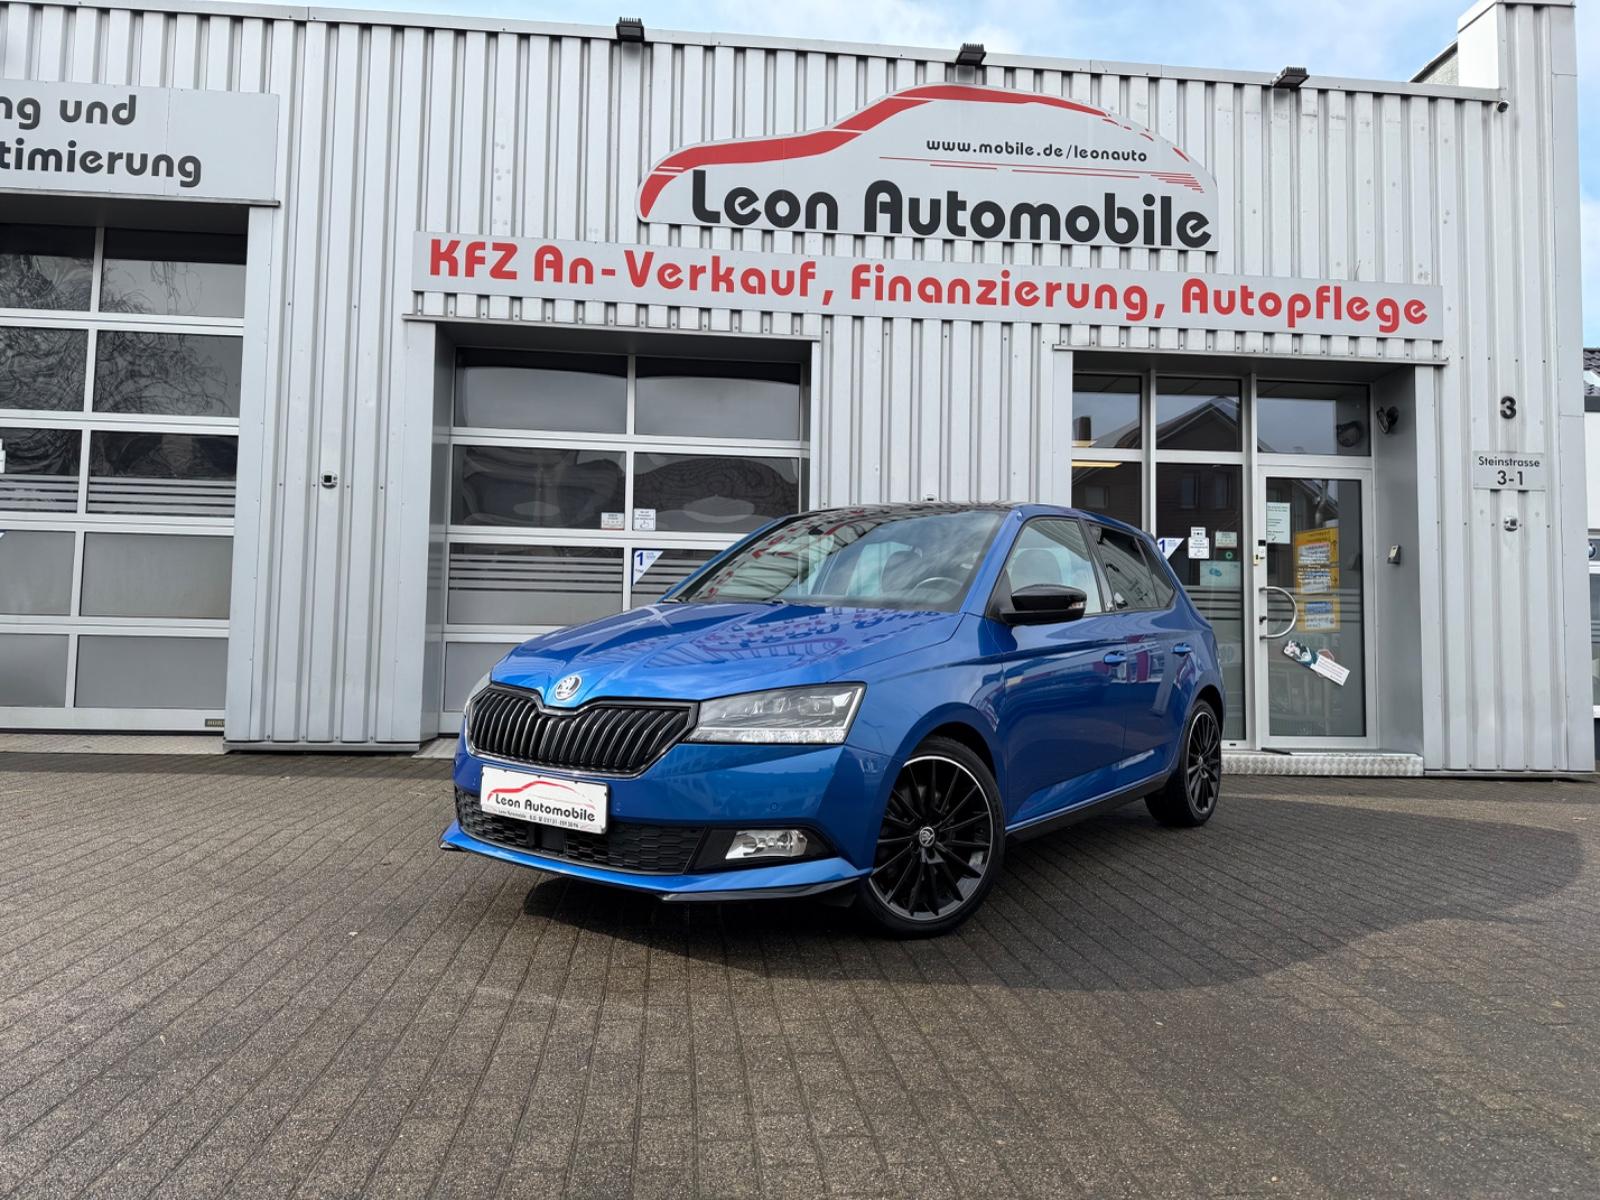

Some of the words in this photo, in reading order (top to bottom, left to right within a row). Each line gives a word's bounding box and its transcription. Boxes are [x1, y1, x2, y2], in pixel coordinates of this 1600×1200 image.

[59, 94, 137, 126] und
[926, 139, 1148, 163] www.mobile.de/leonauto
[692, 169, 839, 231] Leon
[863, 179, 1212, 249] Automobile
[534, 245, 833, 306] An-Verkauf,
[851, 263, 1165, 322] Finanzierung,
[1181, 278, 1428, 334] Autopflege
[1499, 395, 1517, 420] 3
[1478, 454, 1541, 468] Steinstrasse
[1496, 469, 1524, 486] 3-1
[495, 793, 521, 809] Leon
[524, 799, 596, 822] Automobile
